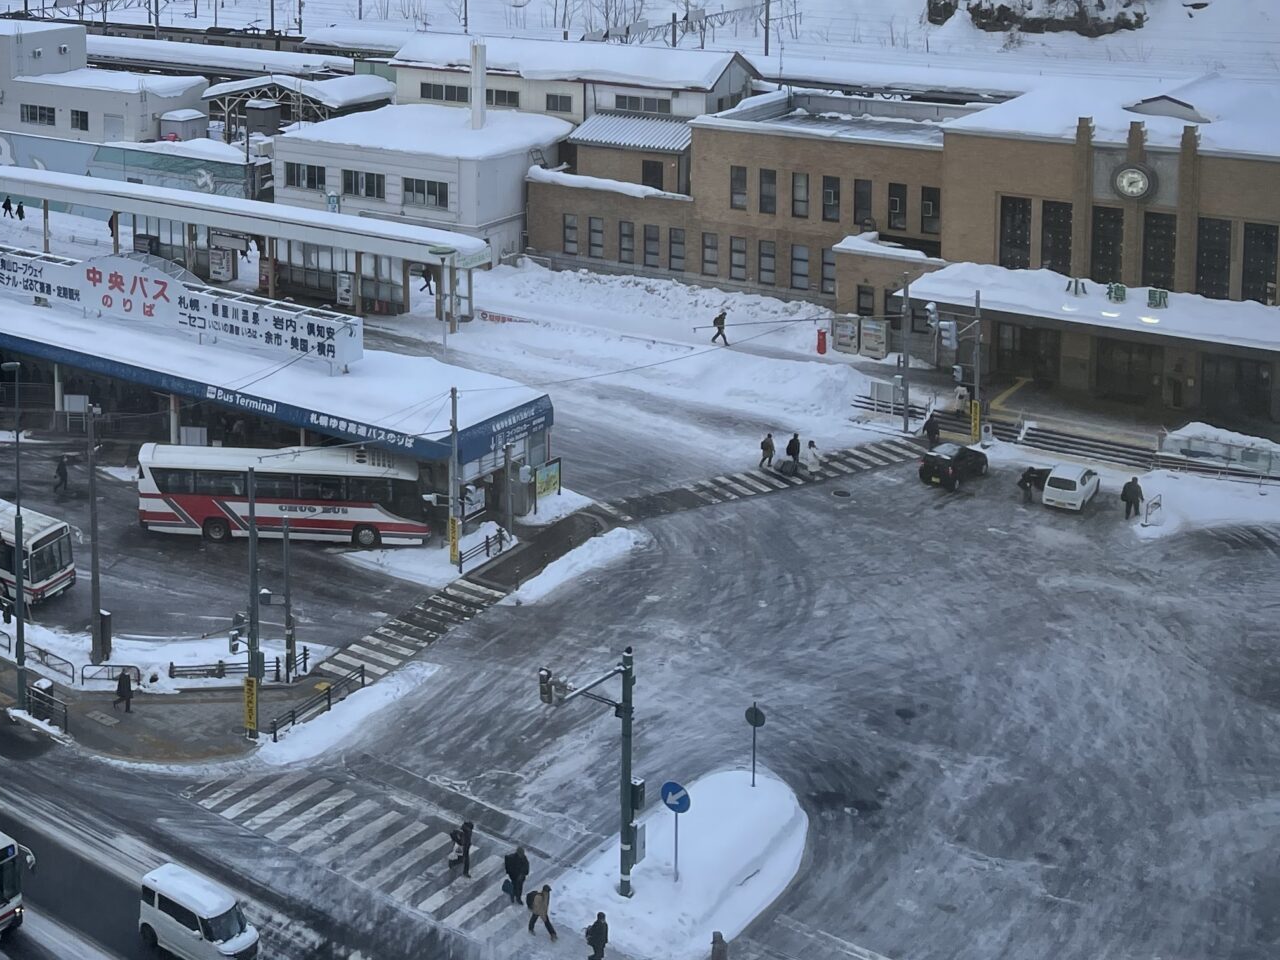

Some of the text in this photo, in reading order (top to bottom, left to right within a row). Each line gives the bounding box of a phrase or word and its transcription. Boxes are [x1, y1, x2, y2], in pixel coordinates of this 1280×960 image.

[86, 267, 170, 303] 中央バス
[1065, 278, 1168, 309] 小樽駅
[102, 294, 155, 317] のりば
[216, 389, 276, 414] Bus Terminal
